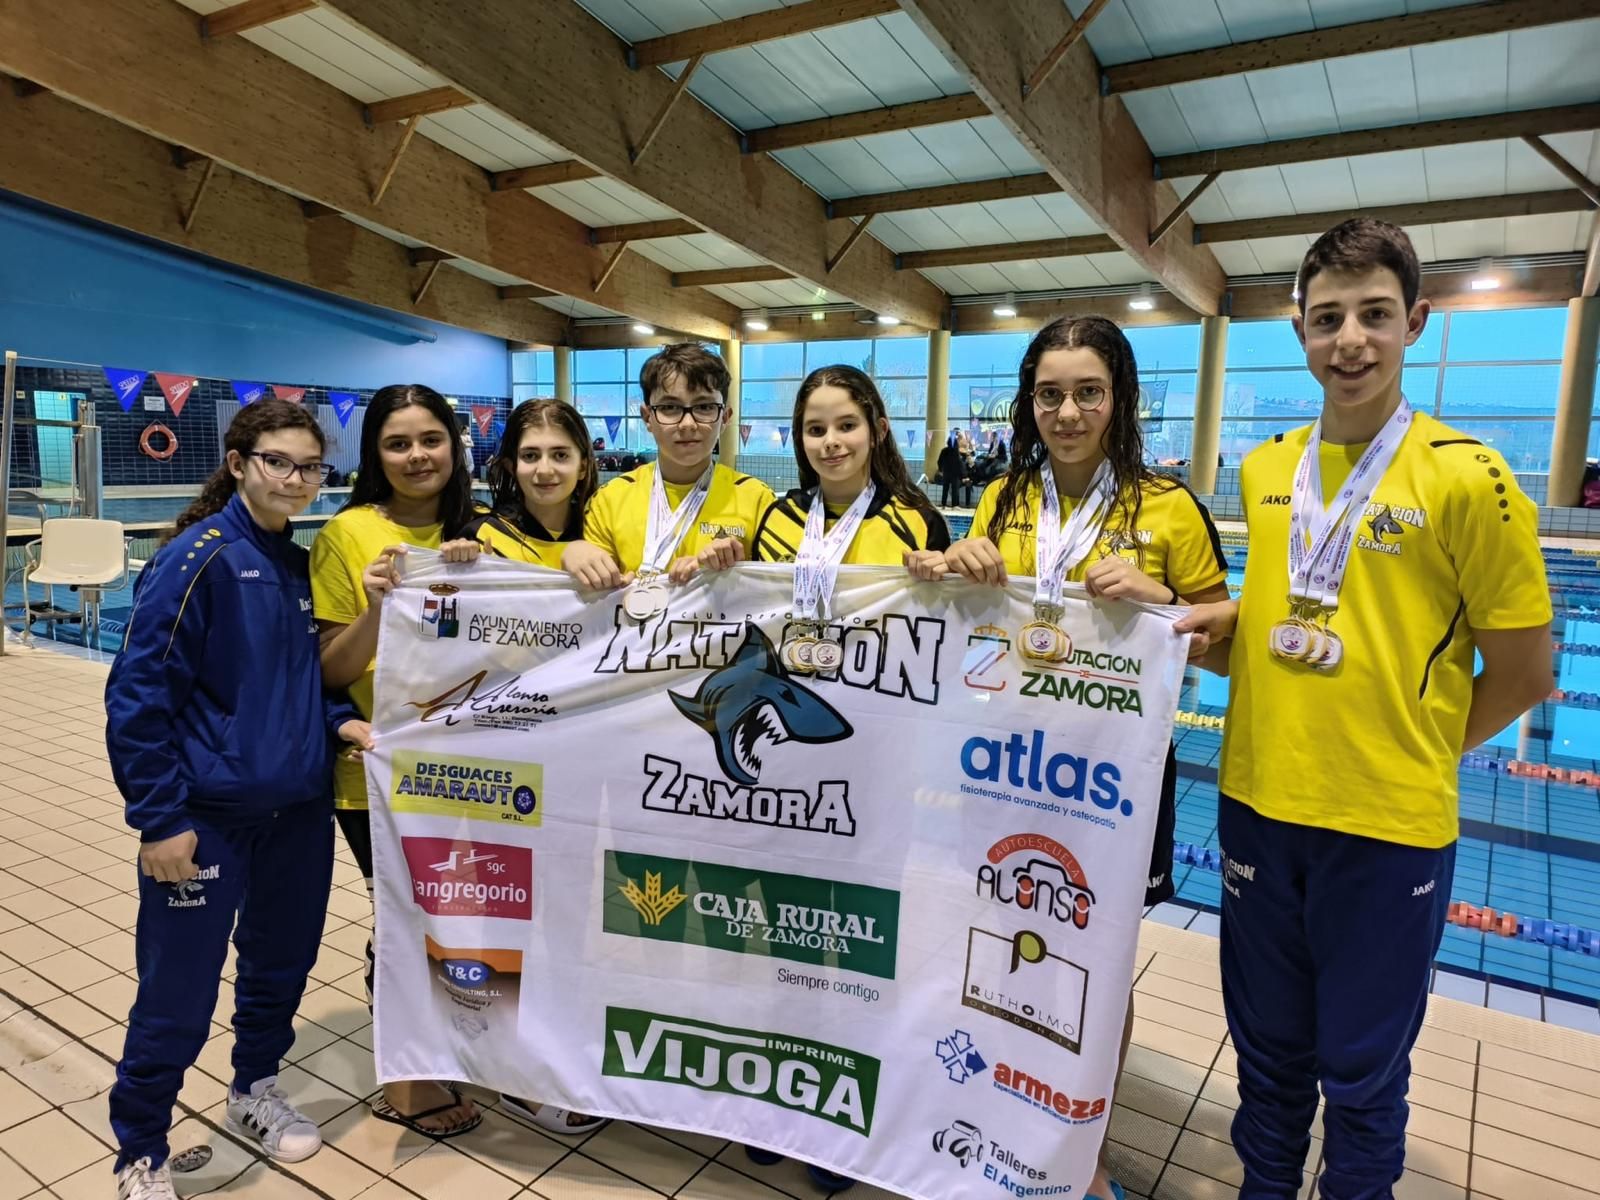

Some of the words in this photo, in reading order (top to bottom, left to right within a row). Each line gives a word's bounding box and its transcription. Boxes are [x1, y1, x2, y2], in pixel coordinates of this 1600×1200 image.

[1261, 495, 1291, 505] JAKO
[1357, 535, 1401, 555] ZAMORA
[240, 570, 260, 578] JAKO
[468, 626, 492, 643] DE
[496, 628, 580, 650] ZAMORA
[470, 614, 583, 635] AYUNTAMIENTO
[1020, 671, 1143, 717] ZAMORA
[416, 762, 512, 783] DESGUACES
[642, 753, 857, 837] ZAMORA
[960, 784, 1012, 802] fisioterapia
[1014, 795, 1060, 813] avanzada
[1062, 807, 1069, 816] y
[502, 813, 512, 821] CAT
[513, 814, 524, 822] S.L.
[487, 862, 506, 874] sgc
[995, 837, 1080, 878] AUTOESCUELA
[414, 879, 527, 904] angregorio
[1411, 879, 1435, 896] JAKO
[168, 896, 206, 908] ZAMORA
[693, 892, 768, 925] CAJA
[777, 903, 884, 944] RURAL
[726, 921, 753, 938] DE
[762, 926, 851, 953] ZAMORA
[446, 963, 482, 981] T&C
[777, 968, 830, 991] Siempre
[833, 981, 880, 1002] contigo
[768, 1039, 856, 1070] IMPRIME
[613, 1019, 866, 1130] VIJOGA
[994, 1062, 1106, 1119] armeza
[990, 1140, 1047, 1181] Talleres
[983, 1163, 997, 1182] El
[999, 1174, 1072, 1198] Argentino
